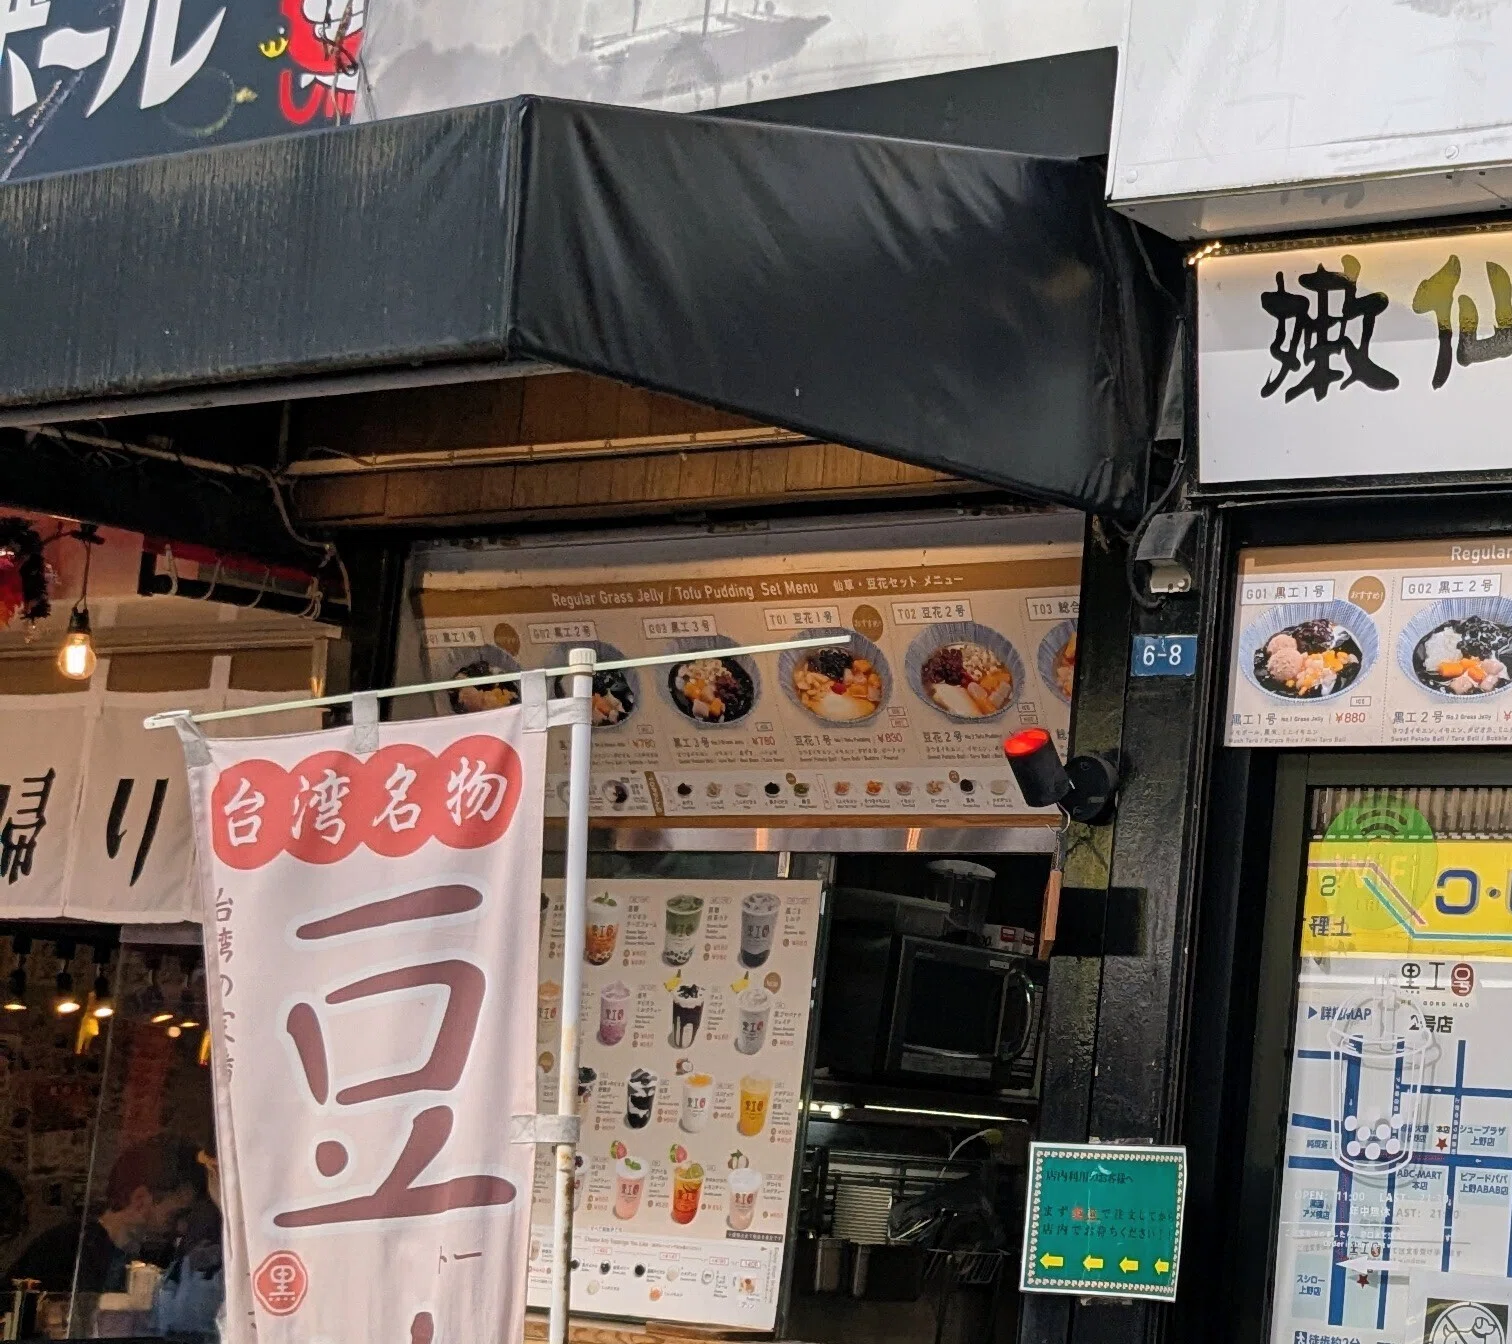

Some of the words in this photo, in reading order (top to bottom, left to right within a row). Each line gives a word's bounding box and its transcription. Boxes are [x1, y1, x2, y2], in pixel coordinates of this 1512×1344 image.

[1451, 545, 1512, 561] Regular
[551, 593, 596, 608] Regular
[599, 591, 634, 605] Grass
[637, 590, 664, 605] Jelly
[675, 587, 702, 601] Tofu
[705, 585, 755, 601] Pudding
[760, 583, 782, 596] Set
[785, 581, 818, 595] Menu
[1246, 587, 1267, 600] G01
[1408, 583, 1432, 595] G02
[1032, 604, 1053, 615] T03
[1142, 643, 1182, 666] 6-8
[1335, 712, 1366, 724] ¥880
[223, 755, 509, 847] 台湾名物
[1397, 1170, 1442, 1181] ABC-MART
[1296, 1274, 1325, 1284] スシロー
